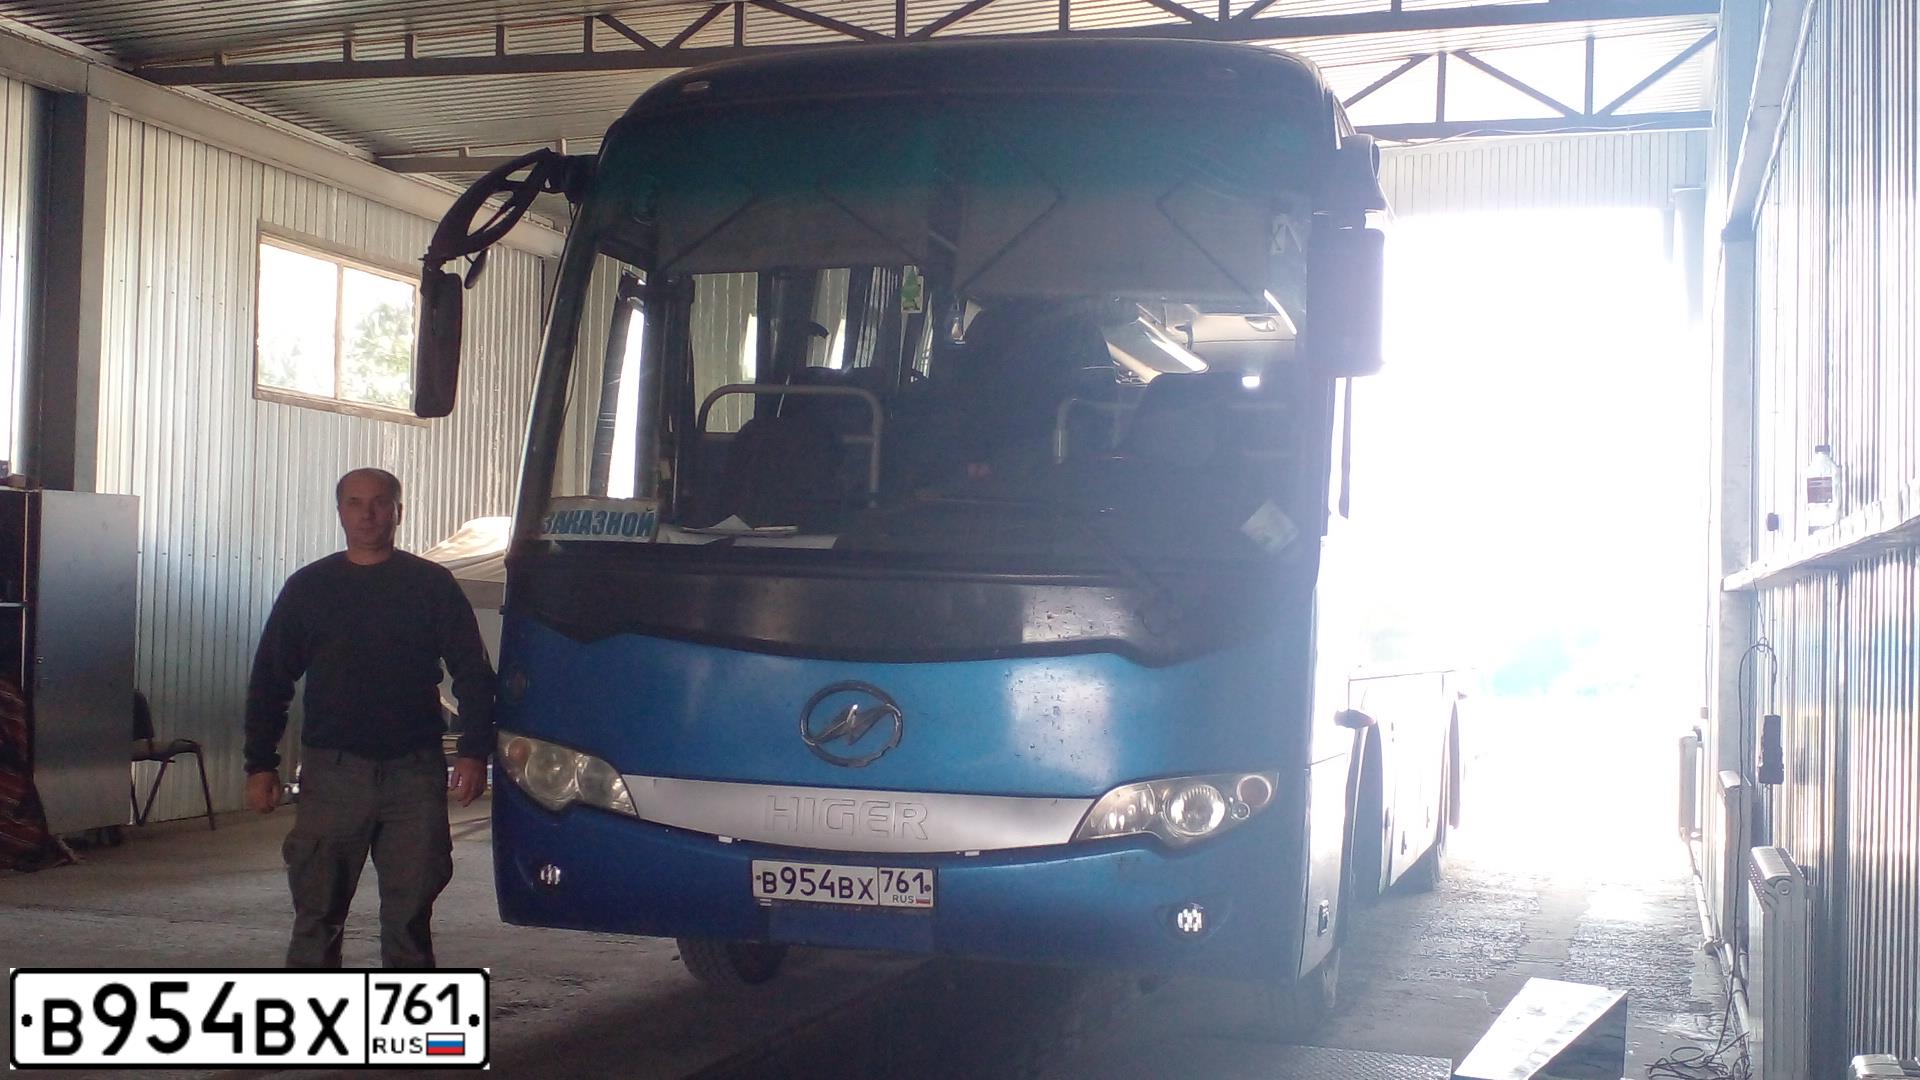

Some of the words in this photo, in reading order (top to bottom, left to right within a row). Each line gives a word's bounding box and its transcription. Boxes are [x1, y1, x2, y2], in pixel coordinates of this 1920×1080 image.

[767, 795, 928, 840] HIGER
[880, 870, 925, 894] 761
[892, 895, 914, 904] RUS
